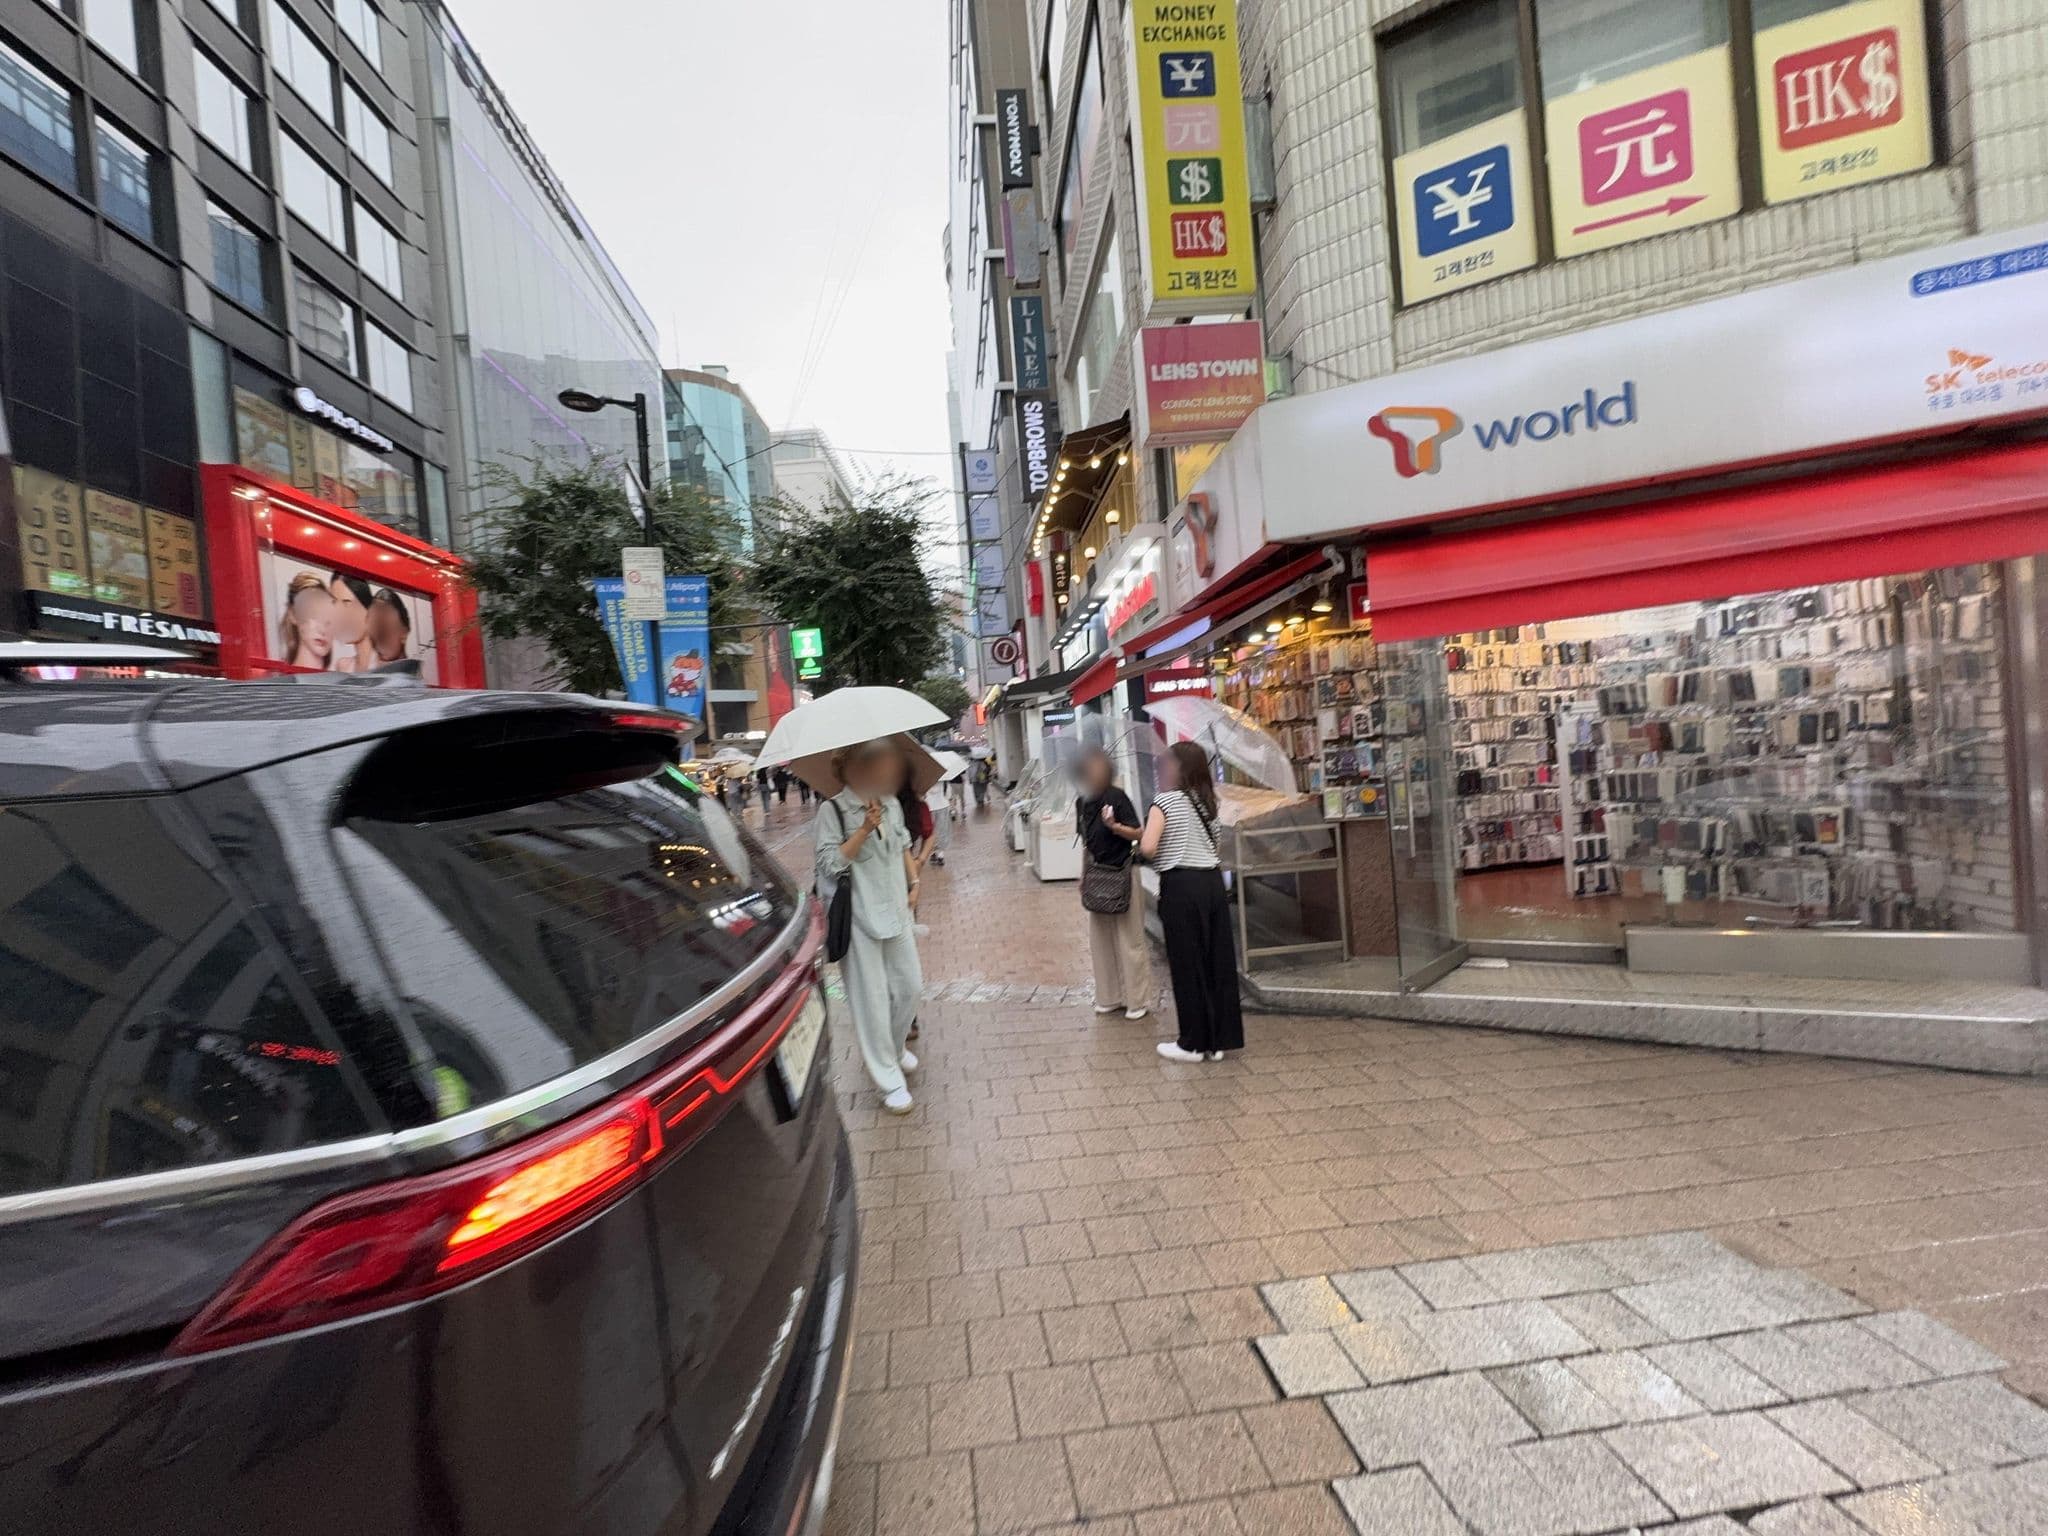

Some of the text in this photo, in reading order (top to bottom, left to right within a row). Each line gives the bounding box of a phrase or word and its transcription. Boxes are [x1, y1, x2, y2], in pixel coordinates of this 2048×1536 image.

[1155, 5, 1216, 21] MONEY
[1143, 24, 1227, 42] EXCHANGE
[1780, 40, 1898, 134] HK$
[1173, 111, 1212, 146] 元
[1594, 107, 1680, 194] 元
[1180, 160, 1211, 202] $
[1174, 215, 1226, 253] HK$
[1168, 269, 1238, 291] 고래환전
[1434, 249, 1495, 283] 고래환전
[1021, 300, 1039, 371] LINE
[1151, 358, 1258, 382] LENS TOWN
[1925, 361, 2048, 394] SK teleco
[1474, 381, 1638, 450] world
[1023, 400, 1048, 493] TOPBROWS
